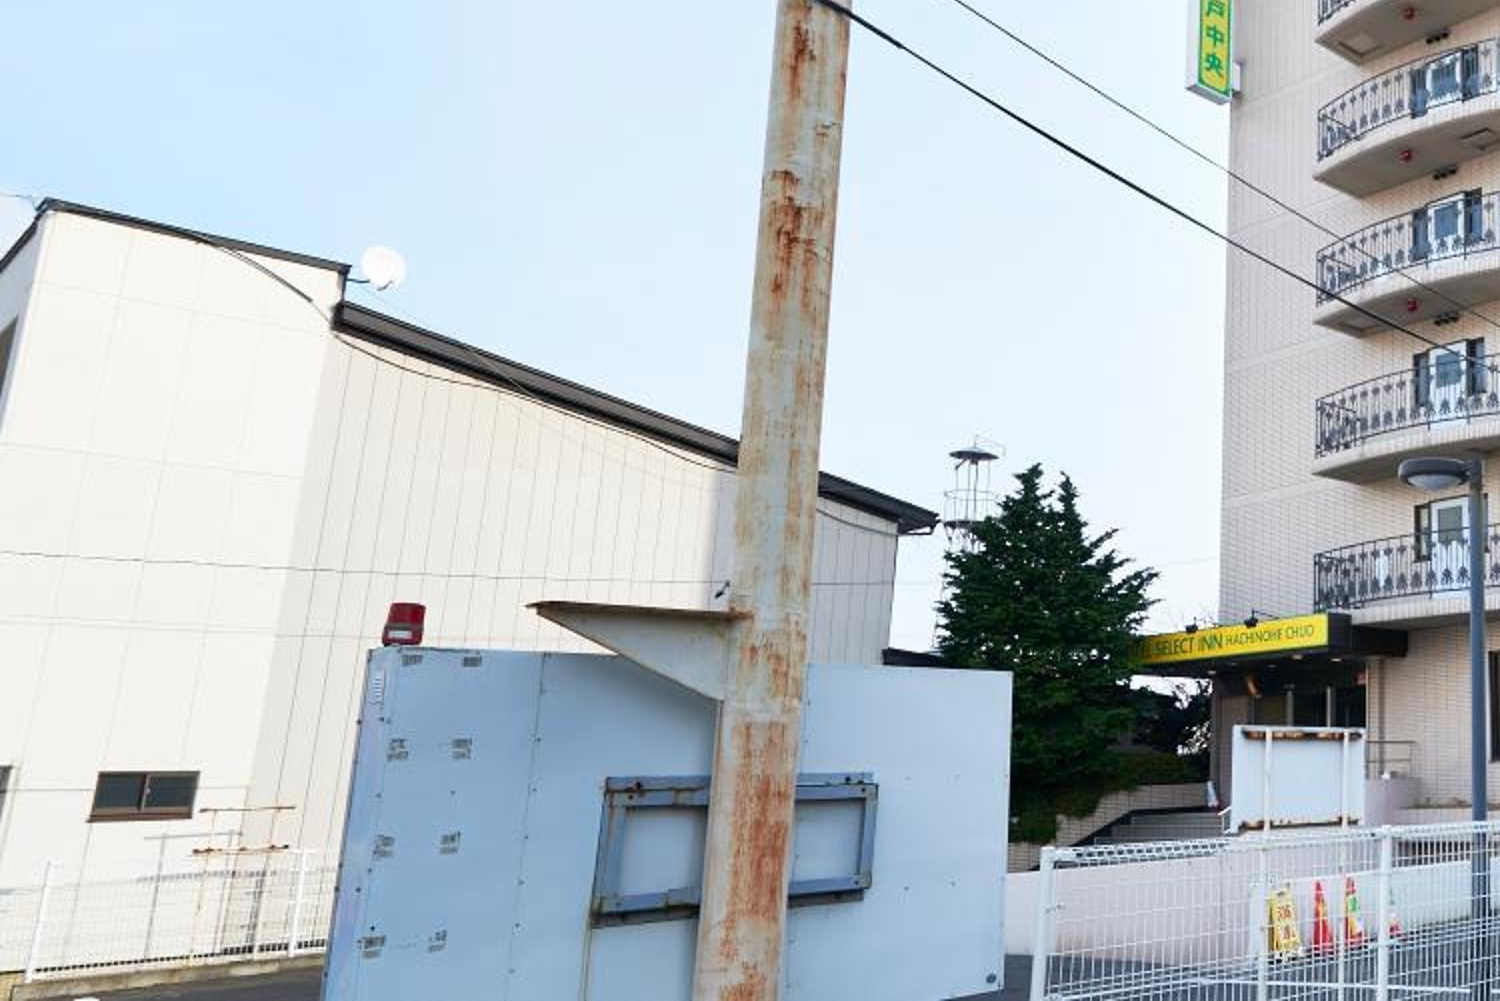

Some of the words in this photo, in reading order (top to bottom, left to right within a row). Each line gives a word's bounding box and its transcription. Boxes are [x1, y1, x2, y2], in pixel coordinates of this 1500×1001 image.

[1152, 636, 1194, 655] SELECT
[1198, 632, 1223, 652] INN
[1225, 627, 1281, 646] HACHINOHE
[1284, 623, 1315, 640] CHUO
